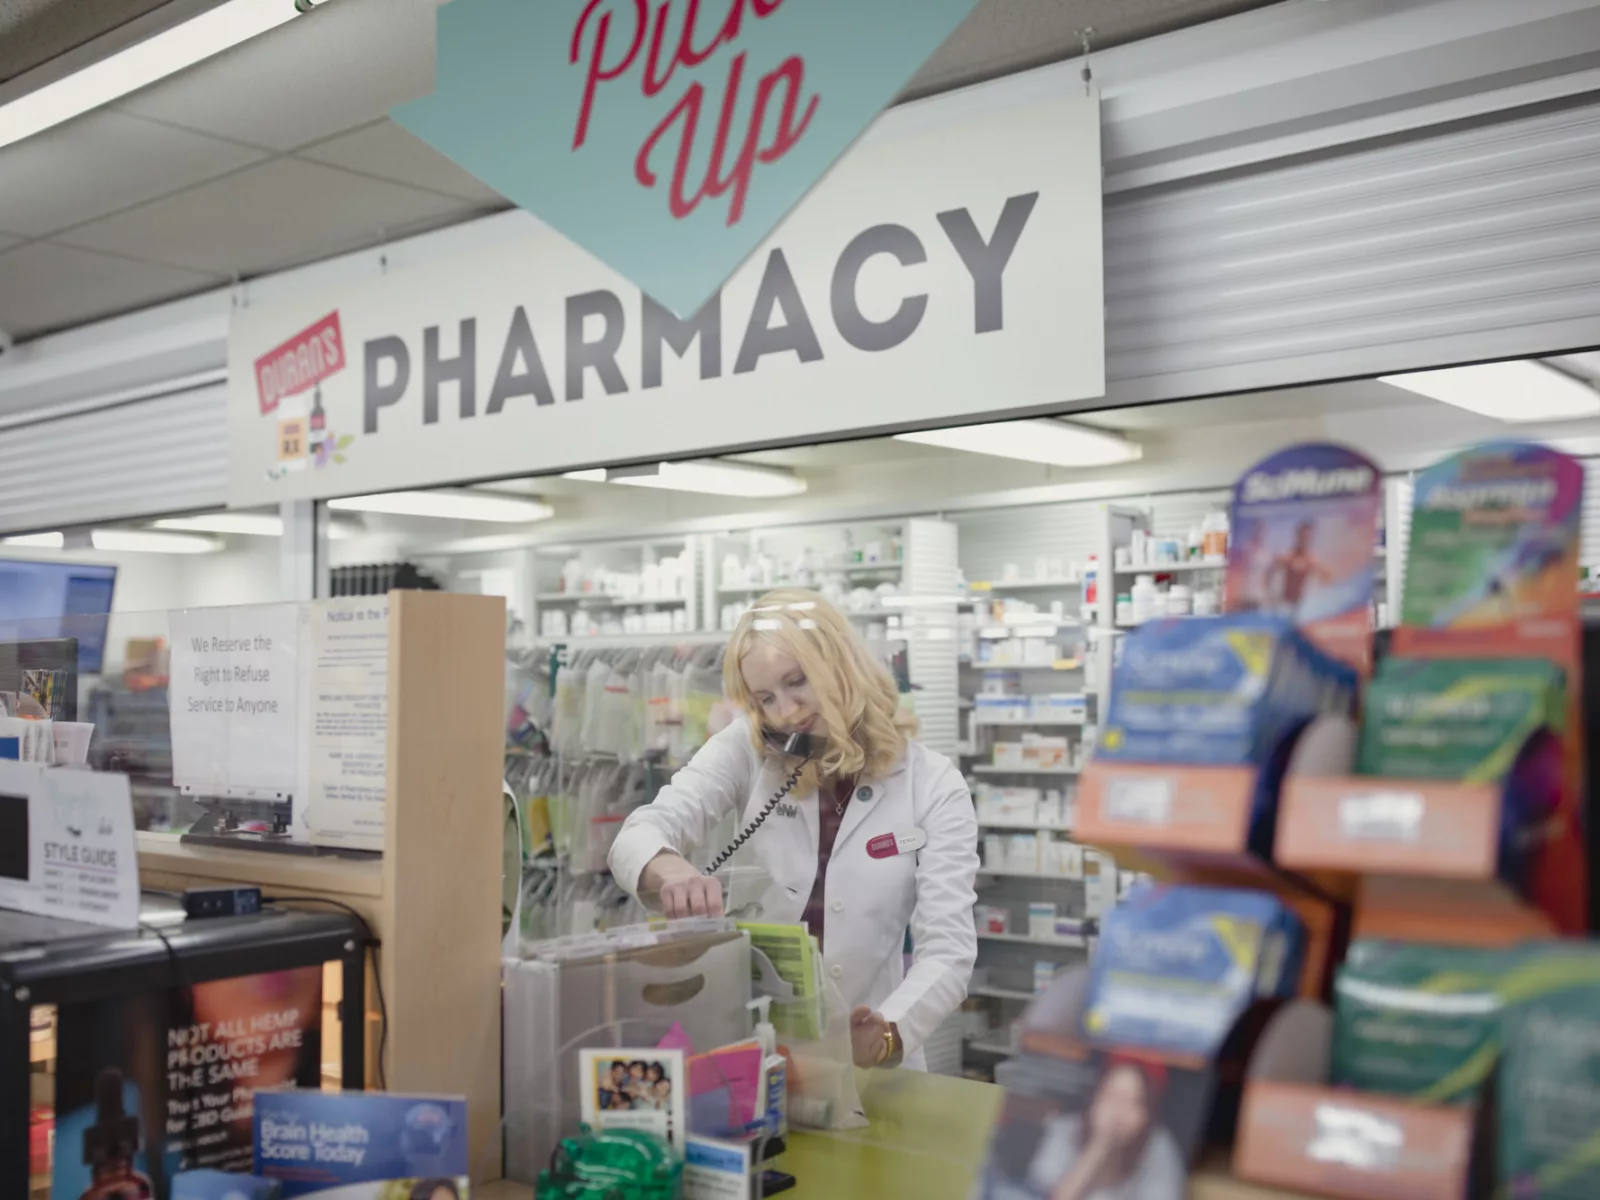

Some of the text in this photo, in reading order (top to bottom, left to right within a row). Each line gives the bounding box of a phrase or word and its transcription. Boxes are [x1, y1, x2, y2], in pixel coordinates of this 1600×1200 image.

[568, 0, 786, 152] Pic
[633, 49, 820, 228] Up
[364, 190, 1039, 434] PHARMACY
[190, 634, 273, 653] We Reserve the
[194, 664, 271, 687] Right to Refuse
[187, 696, 279, 716] Service to Anyone
[43, 842, 118, 869] STYLE GUIDE
[168, 1008, 300, 1049] NOT ALL HEMP
[167, 1028, 303, 1071] PRODUCTS ARE
[167, 1067, 205, 1093] THE
[208, 1057, 260, 1085] SAME
[167, 1098, 200, 1116] Trut
[260, 1117, 370, 1144] Brain Health
[260, 1139, 310, 1161] Score
[313, 1141, 366, 1168] Today
